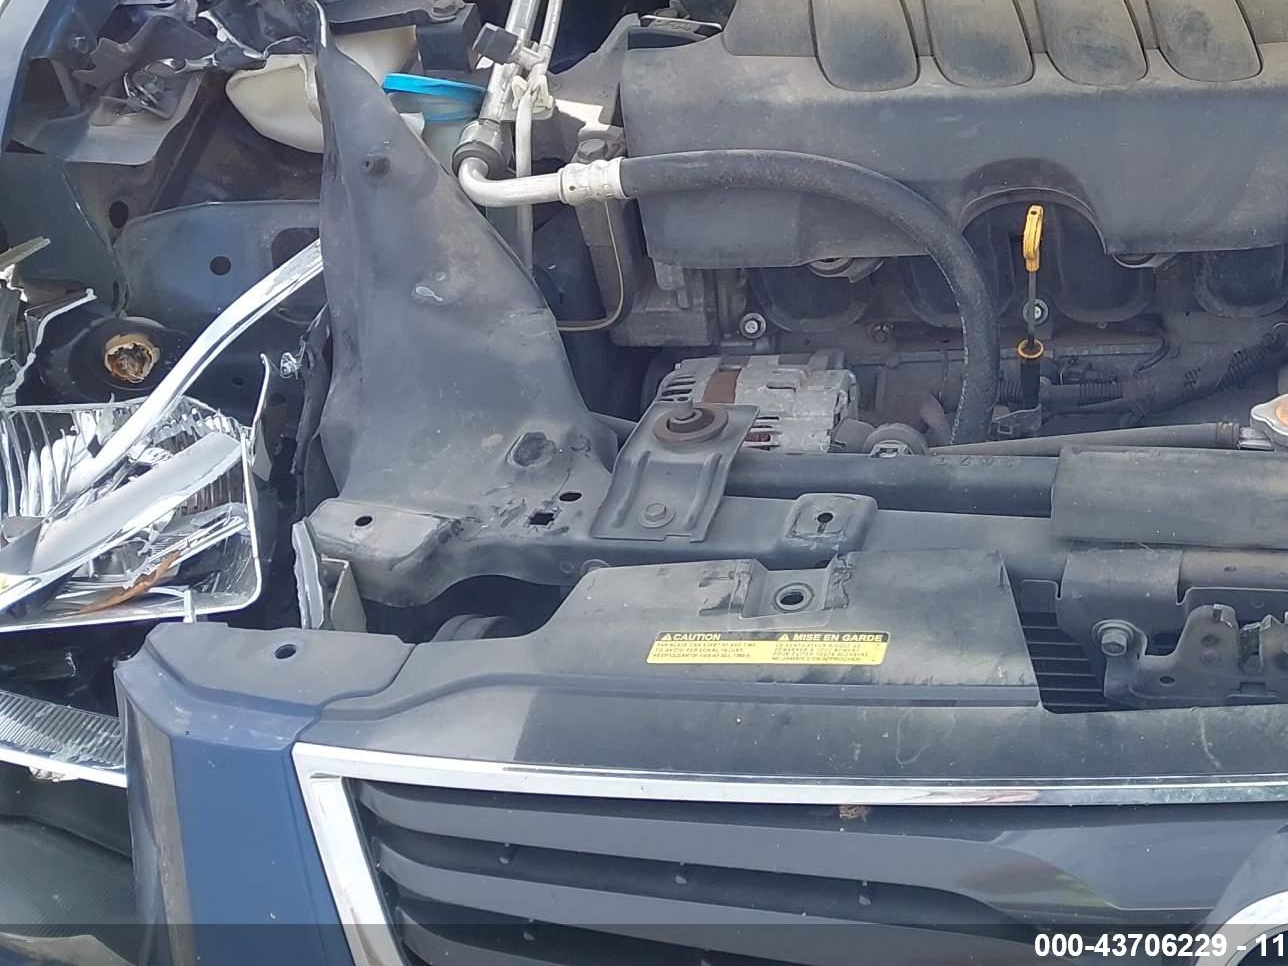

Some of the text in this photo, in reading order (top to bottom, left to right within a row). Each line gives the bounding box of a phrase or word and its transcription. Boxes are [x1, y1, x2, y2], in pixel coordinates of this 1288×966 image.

[673, 633, 721, 641] CAUTION
[793, 633, 821, 641] MISE
[842, 634, 883, 642] GARDE
